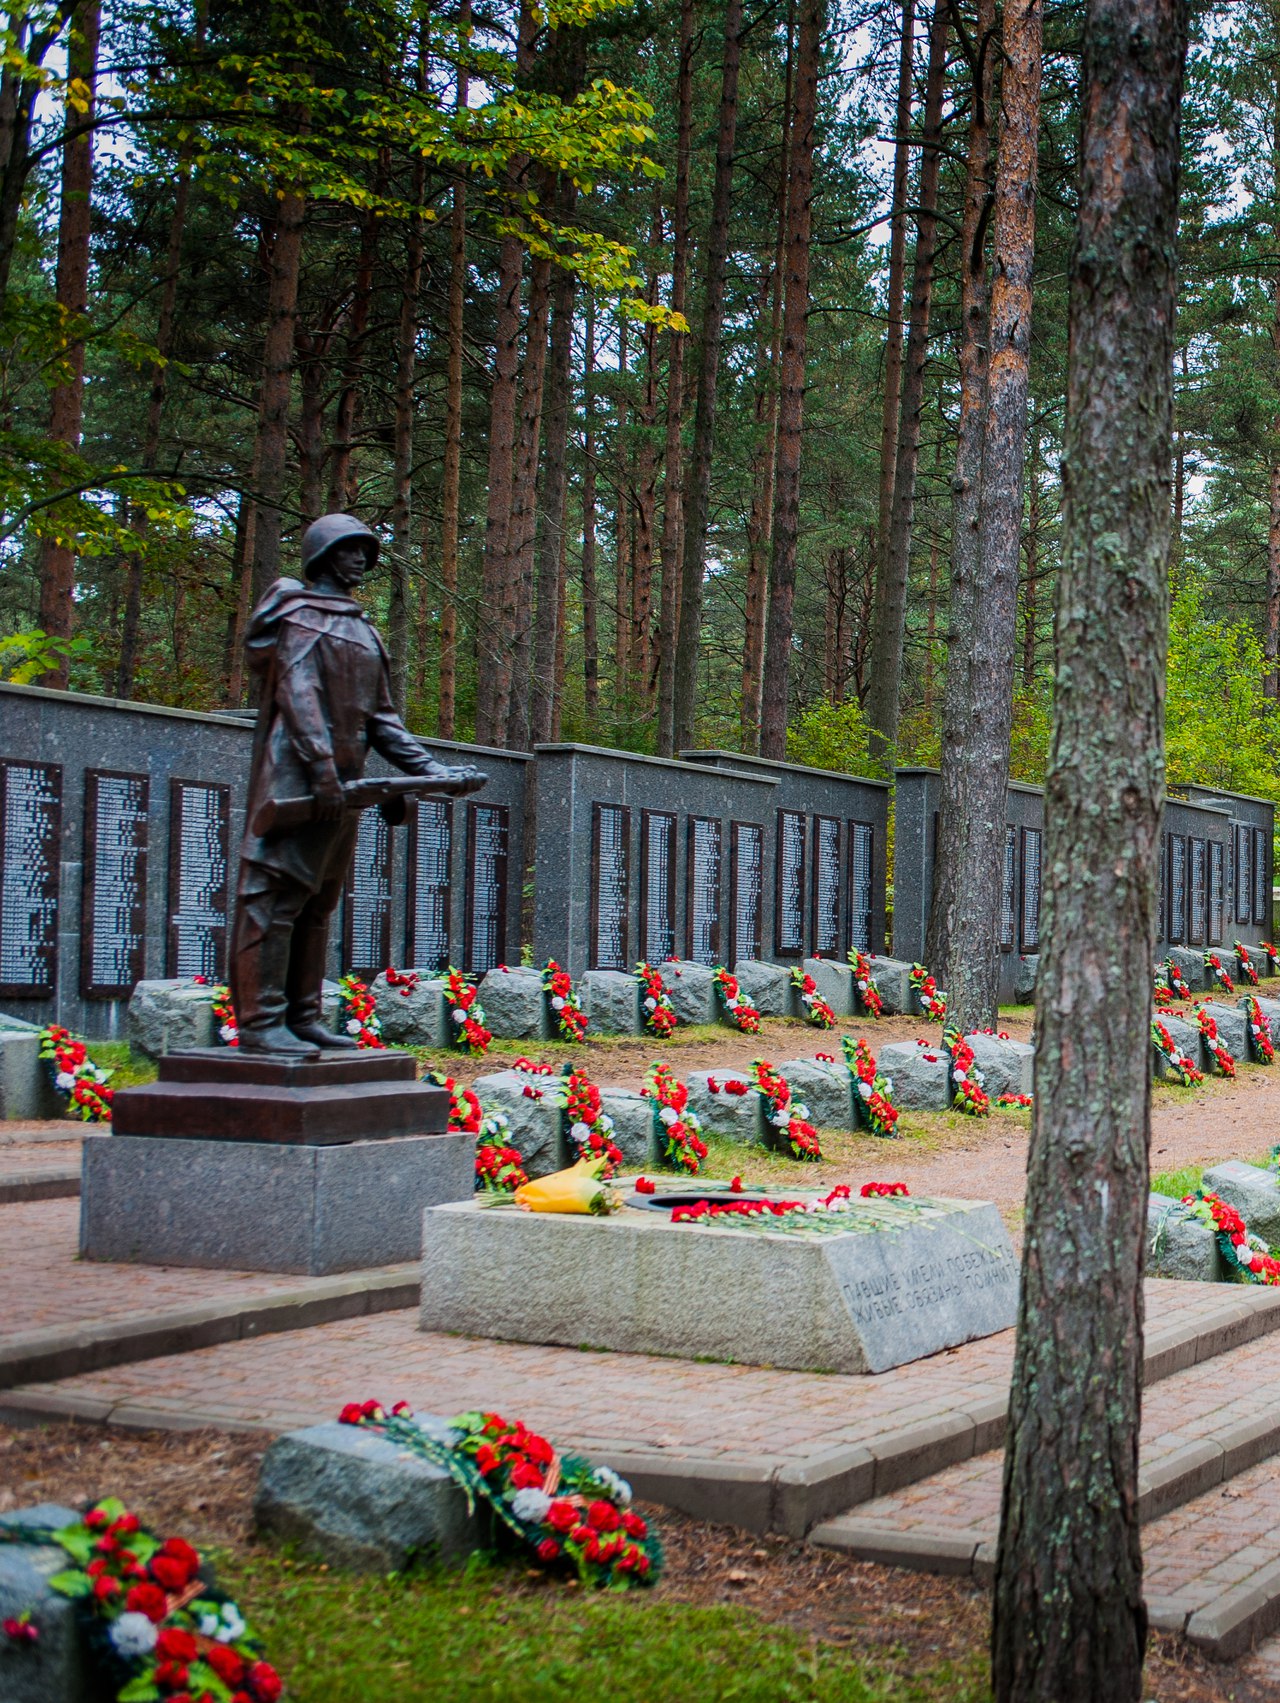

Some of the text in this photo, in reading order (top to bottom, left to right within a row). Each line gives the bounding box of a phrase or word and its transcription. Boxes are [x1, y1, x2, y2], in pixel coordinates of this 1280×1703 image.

[843, 1245, 1014, 1304] ПАВШИЕ УМЕЛИ ПОБЕЖДАТЬ
[852, 1264, 1022, 1324] ЖИВЫЕ ОБЯЗАНЫ ПОМНИТЬ
